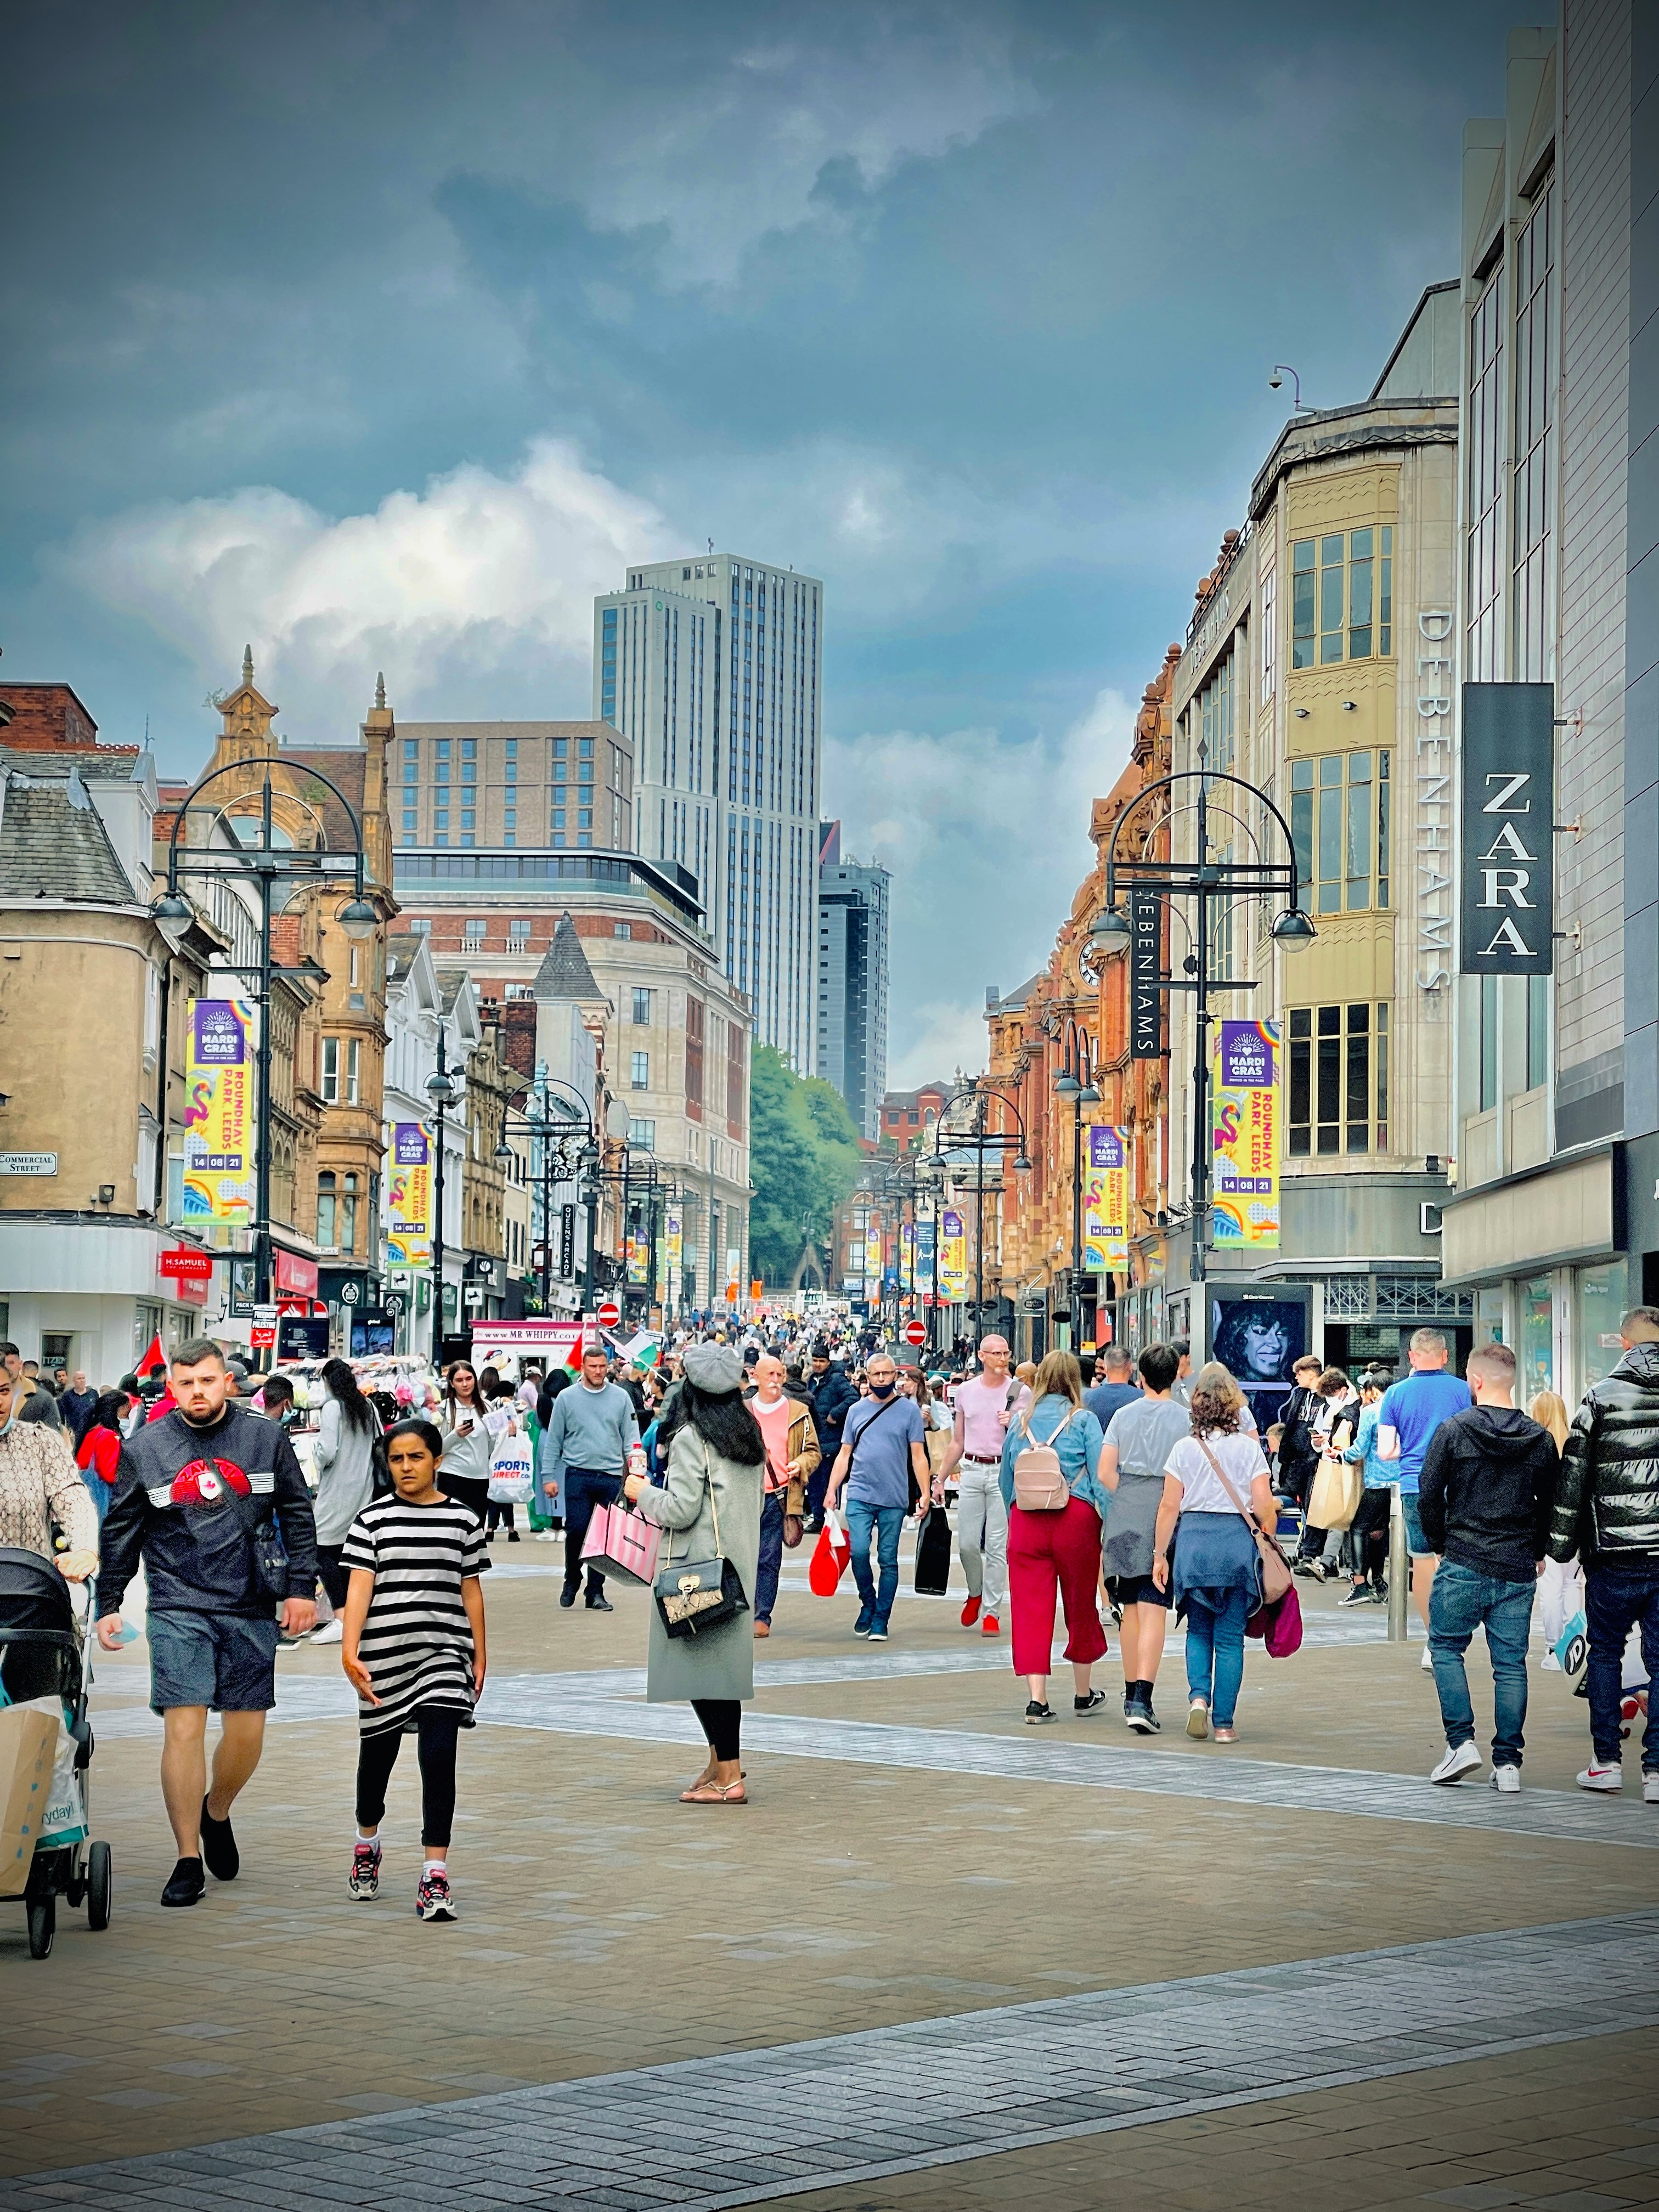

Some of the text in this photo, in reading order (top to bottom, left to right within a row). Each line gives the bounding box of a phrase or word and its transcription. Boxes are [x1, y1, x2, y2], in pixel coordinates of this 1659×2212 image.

[1416, 611, 1452, 990] DEBENHAMS
[1477, 774, 1538, 956] ZARA
[202, 1035, 237, 1044] MARDI
[204, 1044, 235, 1053] GRAS
[1229, 1057, 1265, 1066] MARDI
[1232, 1066, 1262, 1075] GRAS
[222, 1069, 233, 1149] PARK LEEDS
[234, 1071, 244, 1147] ROUNDHAY
[1251, 1091, 1261, 1173] PARK LEEDS
[1262, 1094, 1272, 1170] ROUNDHAY
[10, 1164, 40, 1172] STREET
[210, 1159, 223, 1167] 08
[229, 1159, 239, 1167] 21
[1224, 1181, 1268, 1190] 14 08 21
[494, 1461, 530, 1472] SPORTS
[1568, 1639, 1583, 1674] JD
